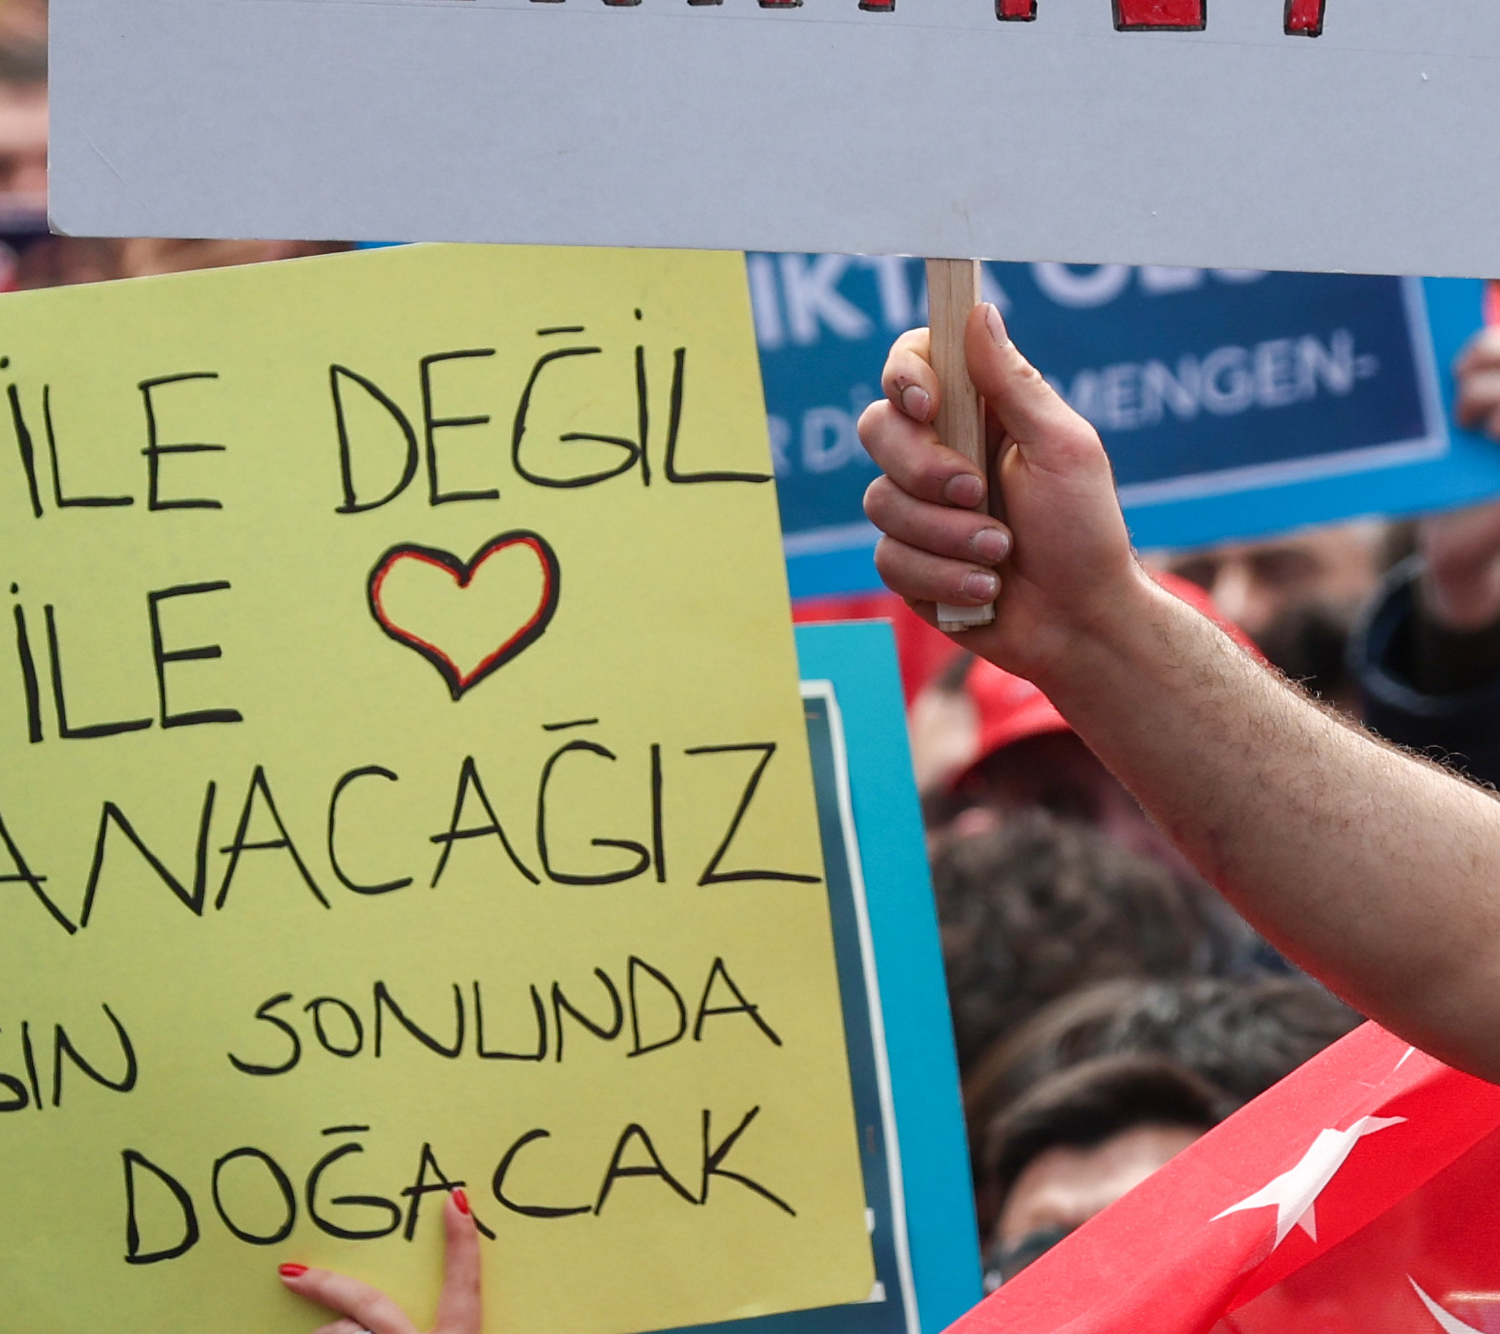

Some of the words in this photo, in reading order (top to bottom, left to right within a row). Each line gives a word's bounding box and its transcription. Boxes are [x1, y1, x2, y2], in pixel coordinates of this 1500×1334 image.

[330, 311, 773, 515] DEĞİL
[10, 580, 244, 744] İLE
[227, 955, 784, 1077] SONUNDA
[125, 1105, 797, 1266] DOĞACAK
